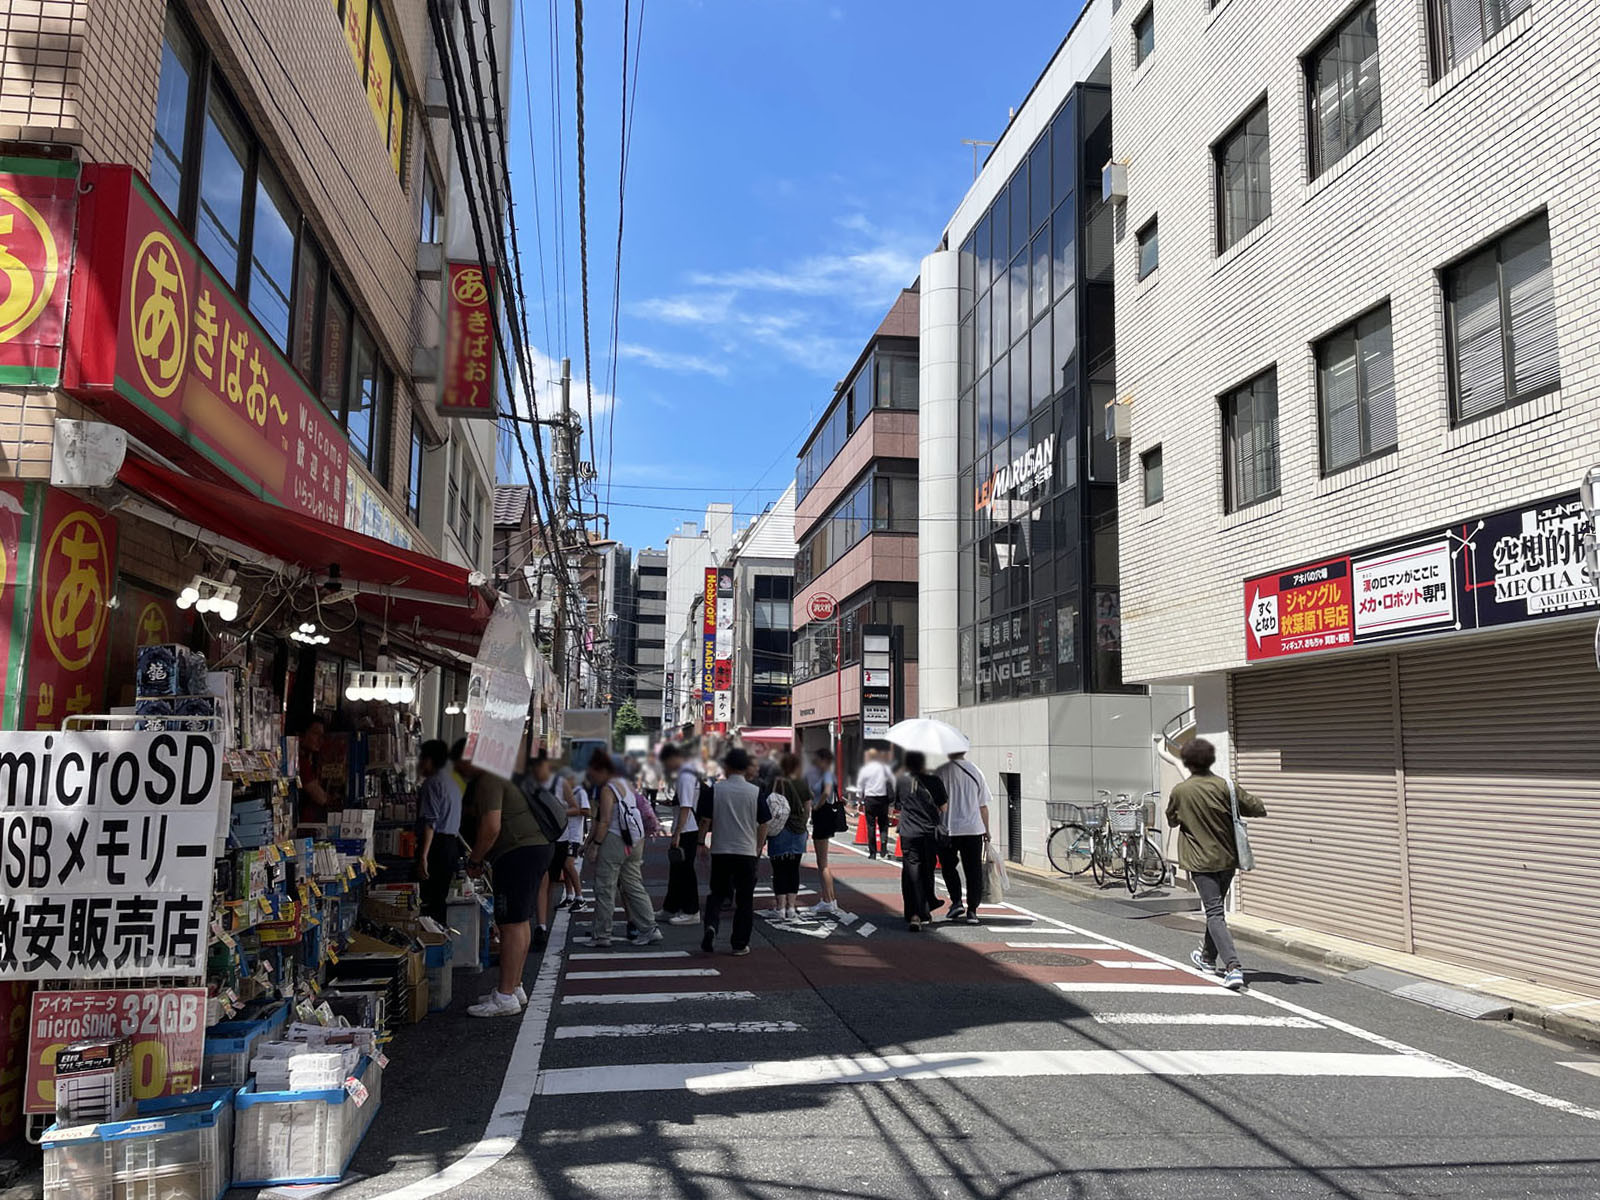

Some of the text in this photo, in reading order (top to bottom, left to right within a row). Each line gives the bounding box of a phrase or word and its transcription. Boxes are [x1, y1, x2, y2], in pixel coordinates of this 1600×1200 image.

[299, 402, 343, 470] Welcome
[992, 433, 1055, 504] MARUSAN
[294, 475, 340, 526] いらっしゃいませ
[1538, 501, 1584, 520] JUNG
[1362, 565, 1440, 593] 漢のロマンがここに
[1497, 570, 1575, 600] MECHA
[1257, 600, 1273, 617] すぐ
[1286, 583, 1342, 612] ジャングル
[1358, 582, 1447, 615] メカ・ロボット専門
[1538, 588, 1596, 608] AKIHABA
[1255, 616, 1277, 632] となり
[1280, 604, 1349, 636] 秋葉原1号店
[718, 692, 727, 718] 牛かつ
[0, 735, 215, 807] microSD
[37, 993, 198, 1039] microSDHC 32GB
[38, 996, 117, 1013] アイオーデータ
